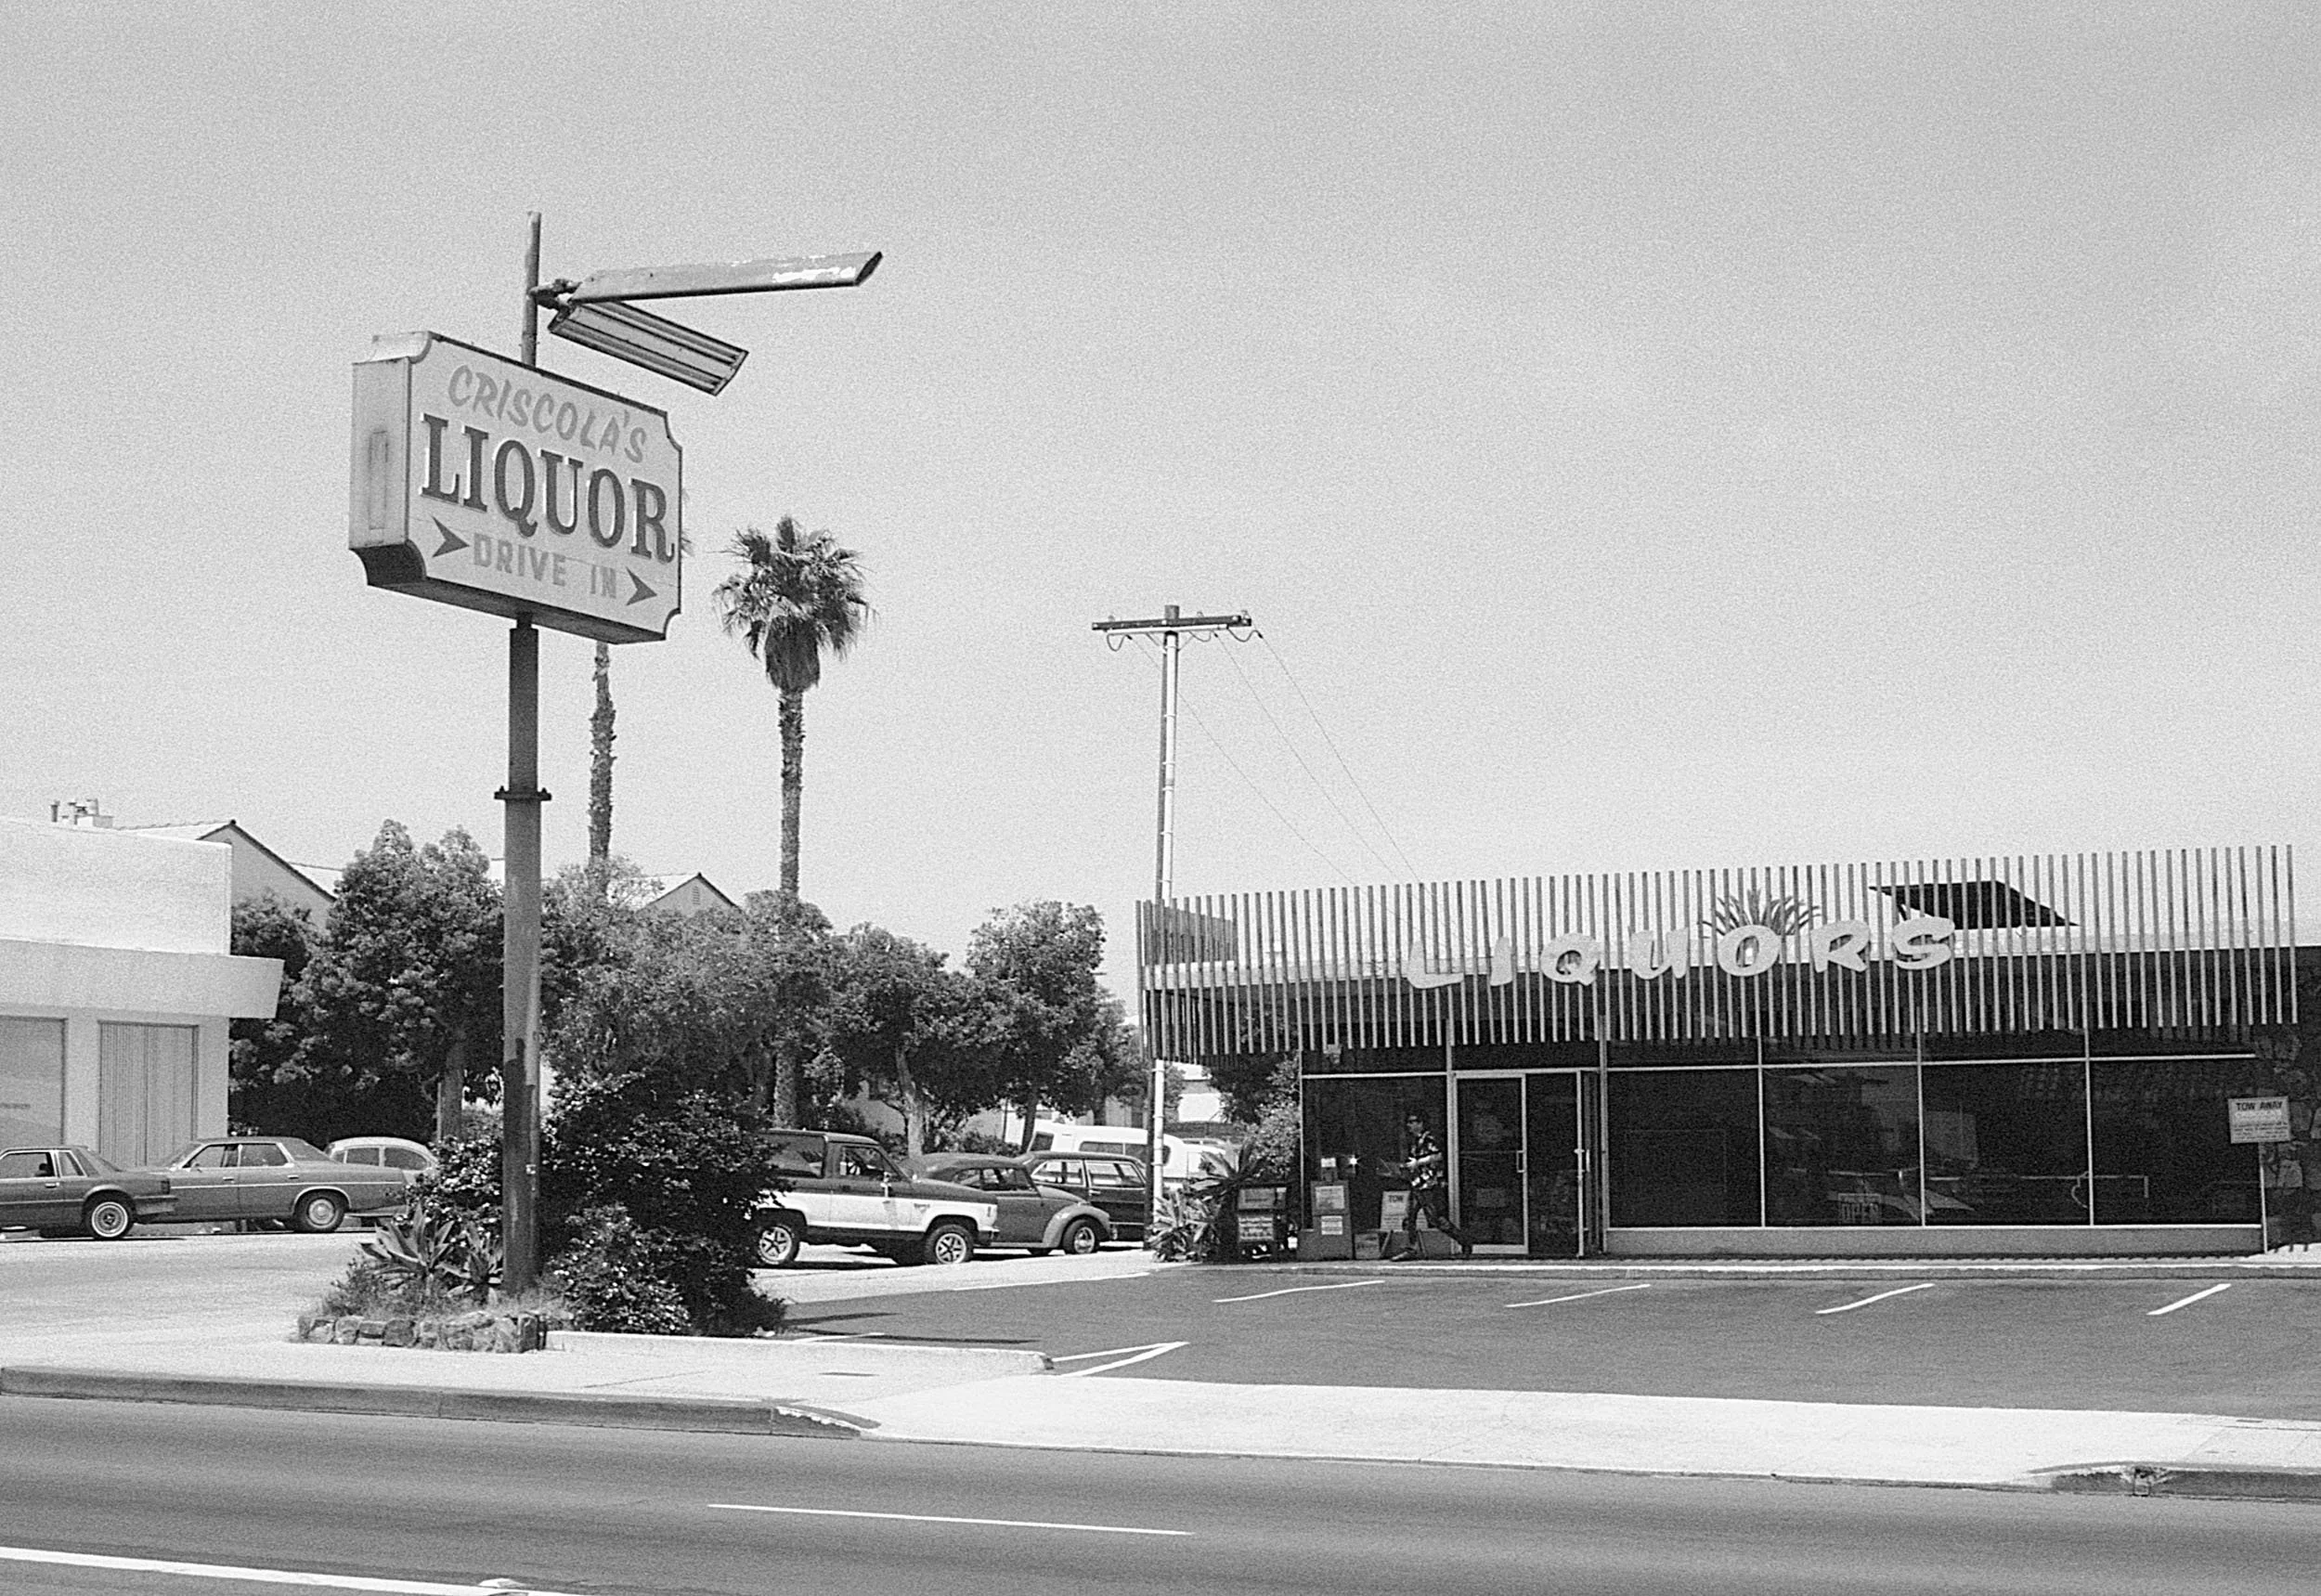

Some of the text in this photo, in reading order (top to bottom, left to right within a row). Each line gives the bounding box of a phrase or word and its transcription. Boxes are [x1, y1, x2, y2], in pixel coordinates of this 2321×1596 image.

[447, 364, 648, 464] CRISCOLA'S
[421, 412, 676, 564] LIQUOR
[473, 532, 617, 600] DRIVE IN
[1407, 915, 1955, 989] LIQUORS
[2236, 1101, 2282, 1110] TOW AWAY
[1841, 1202, 1879, 1224] OPEN
